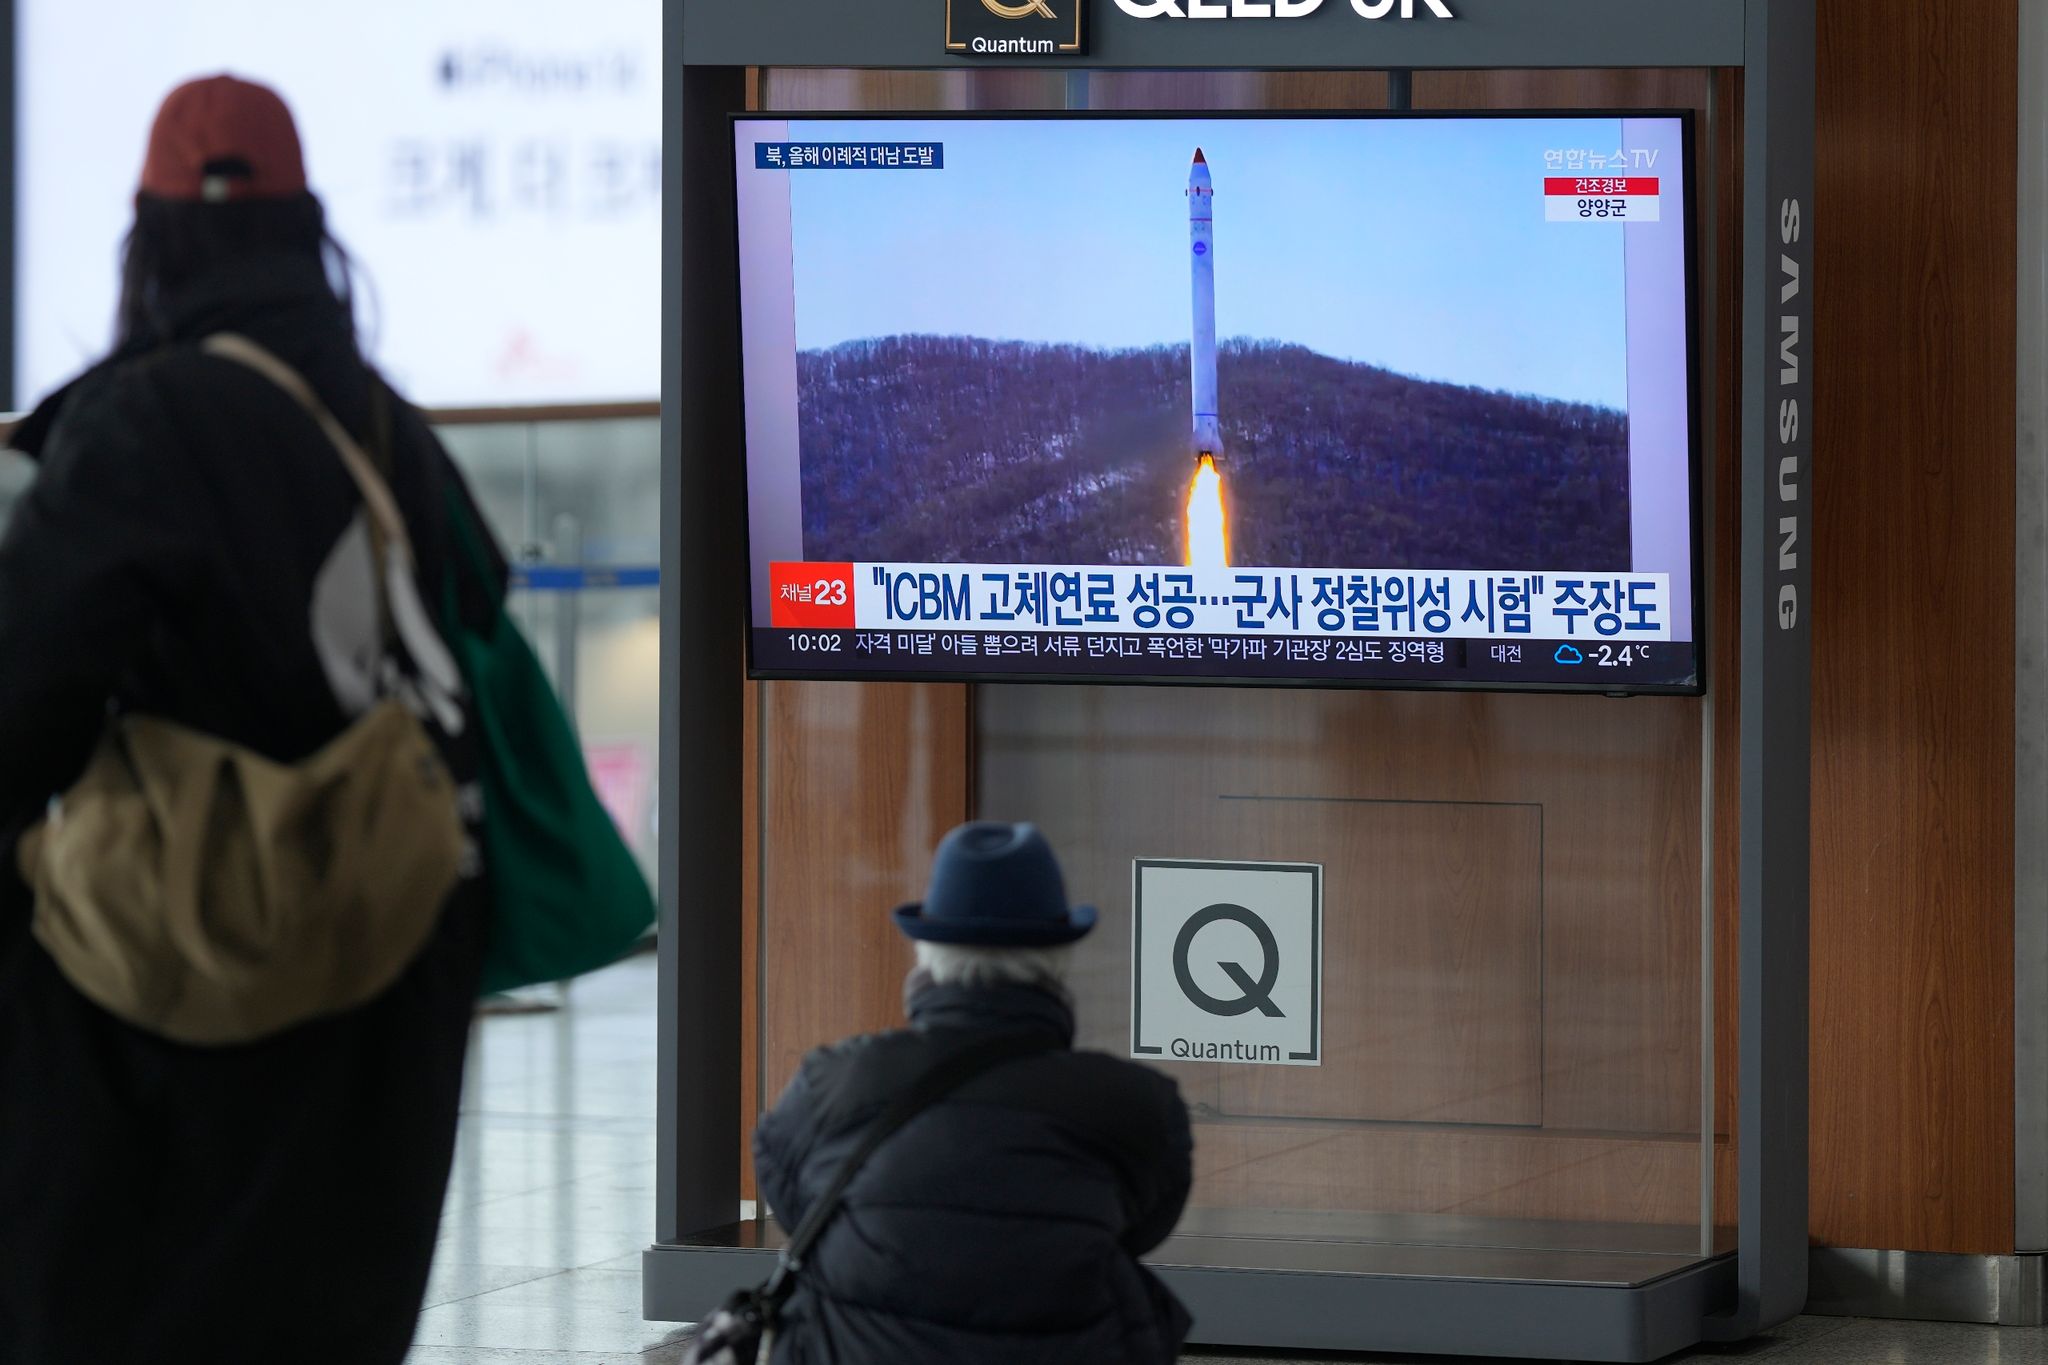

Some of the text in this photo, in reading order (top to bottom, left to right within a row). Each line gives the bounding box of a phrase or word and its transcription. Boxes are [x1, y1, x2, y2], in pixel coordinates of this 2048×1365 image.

[971, 36, 1054, 53] Quantum
[766, 146, 934, 168] 북, 올해 이례적 대남 도발
[1543, 148, 1660, 170] 연합뉴스TV
[1575, 178, 1628, 194] 건조경보
[1577, 198, 1627, 218] 양양군
[1778, 198, 1800, 631] SAMSUNG
[872, 566, 971, 621] "ICBM
[980, 571, 1120, 627] 고체연료
[1311, 575, 1452, 634] 정찰위성
[1460, 575, 1544, 634] 시험"
[1552, 579, 1661, 636] 주장도
[788, 633, 842, 652] 10:02
[855, 632, 891, 655] 자격
[941, 633, 978, 655] 아들
[983, 634, 1038, 657] 뽑으려
[1044, 635, 1082, 657] 서류
[1087, 636, 1142, 658] 던지고
[1147, 636, 1204, 659] 폭언한
[1207, 636, 1268, 660] '막가파
[1273, 638, 1331, 661] 기관장'
[1335, 639, 1383, 662] 2심도
[1388, 640, 1444, 663] 징역형
[1490, 644, 1522, 663] 대전
[1172, 903, 1286, 1018] Q
[1170, 1037, 1281, 1061] Quantum
